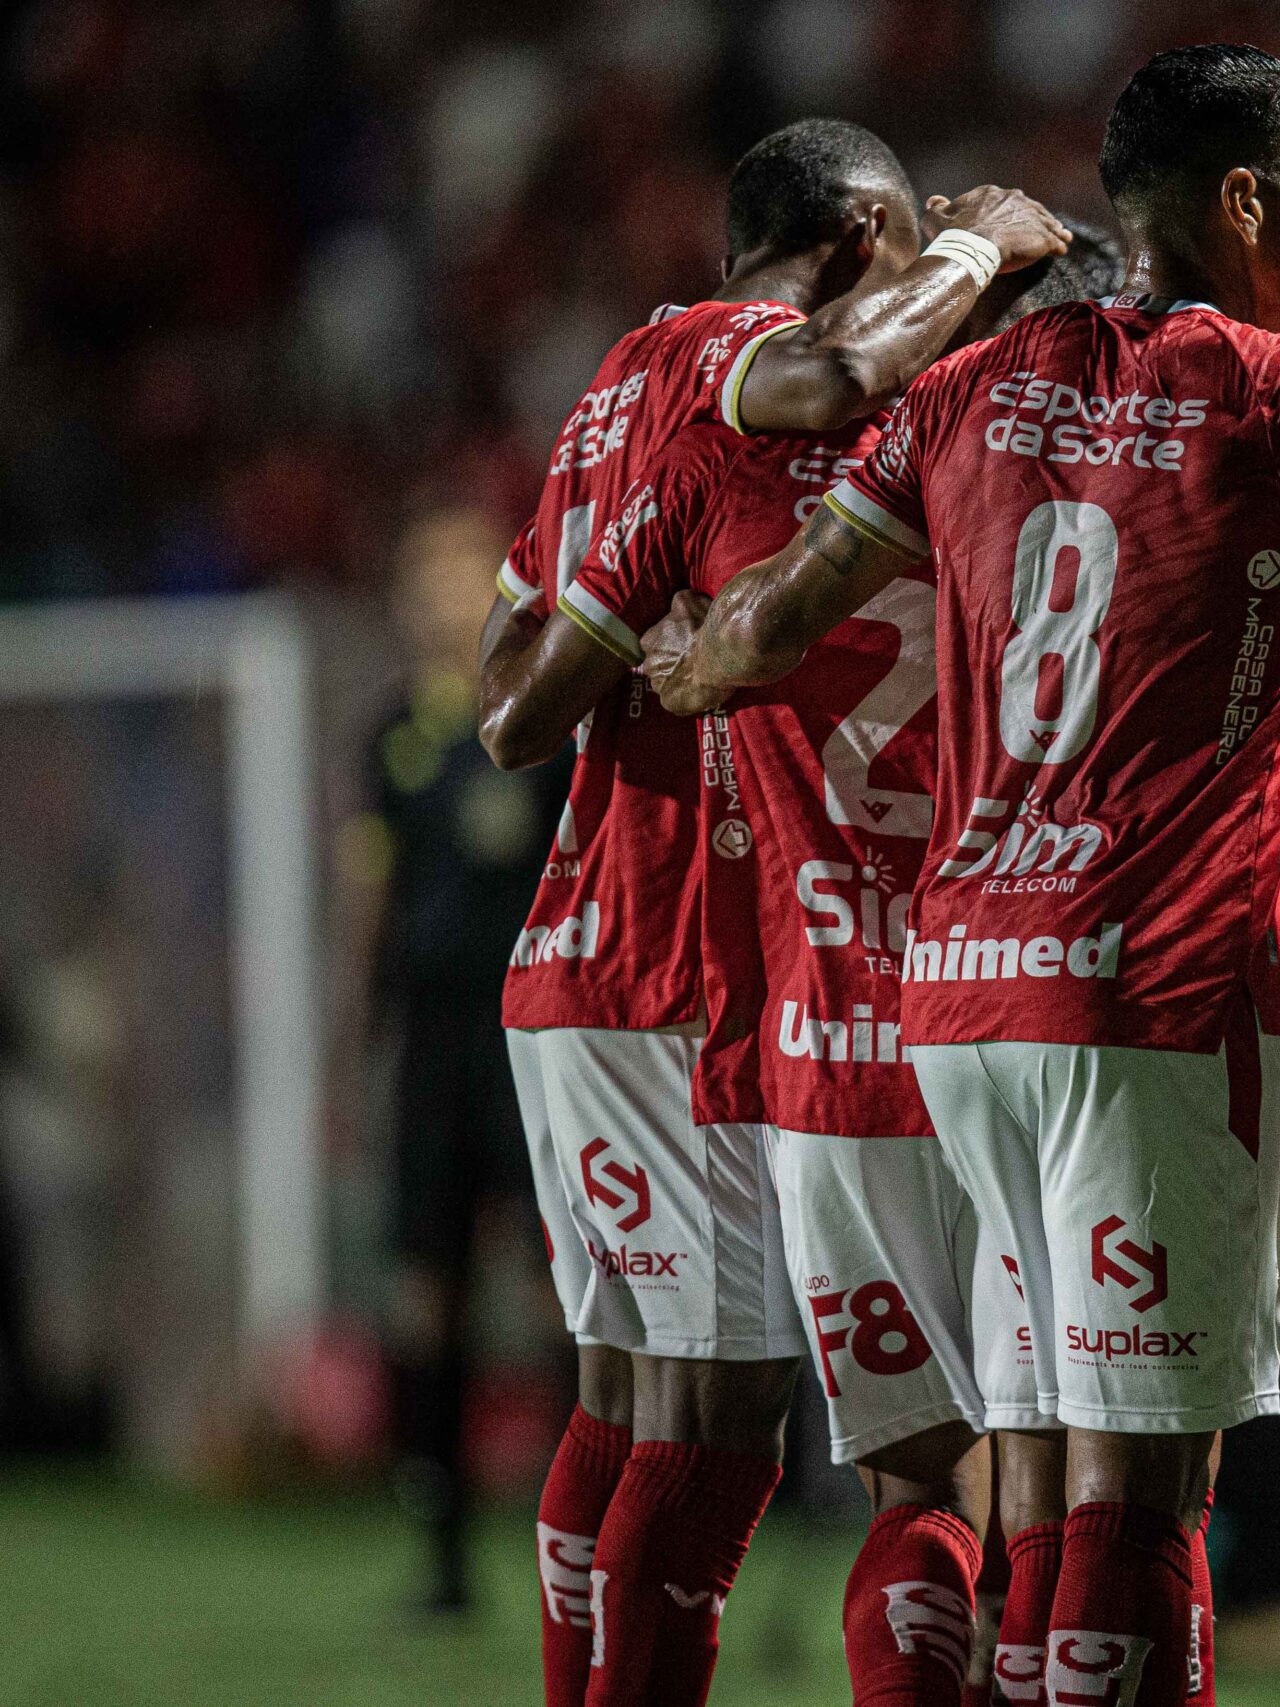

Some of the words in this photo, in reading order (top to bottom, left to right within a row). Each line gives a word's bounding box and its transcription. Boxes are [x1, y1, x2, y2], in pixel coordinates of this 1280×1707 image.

[989, 371, 1210, 428] Esportes
[984, 414, 1044, 458] da
[1047, 424, 1185, 471] Sorte
[998, 500, 1119, 764] 8
[1249, 625, 1275, 697] CASA
[980, 876, 1077, 895] TELECOM
[808, 1279, 934, 1399] F8
[1066, 1323, 1199, 1362] suplax
